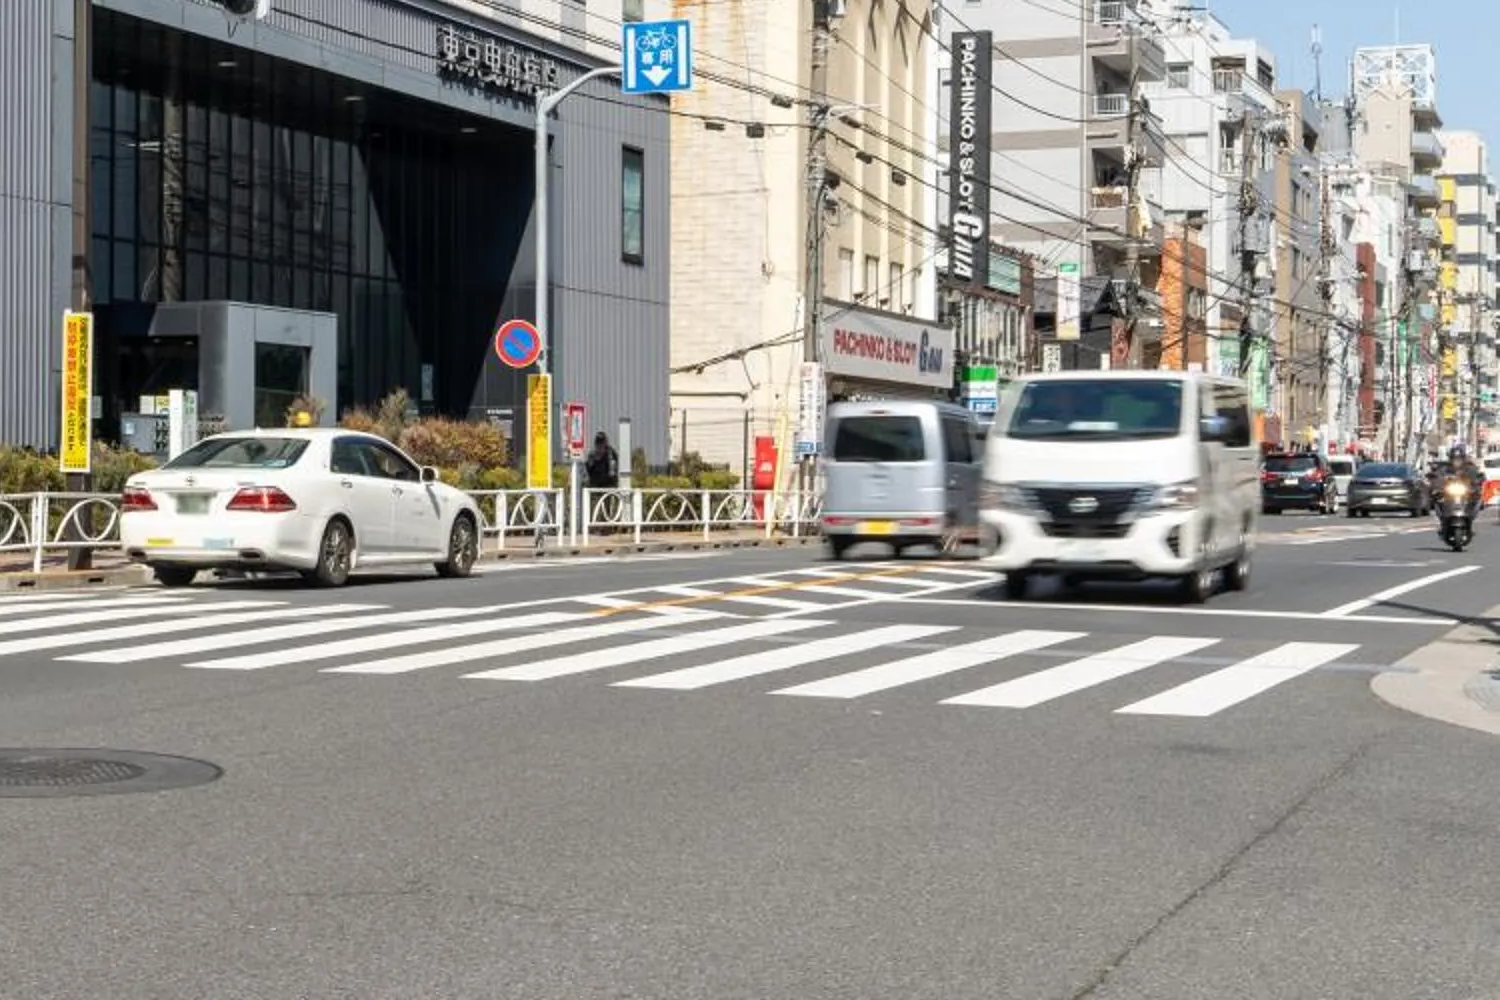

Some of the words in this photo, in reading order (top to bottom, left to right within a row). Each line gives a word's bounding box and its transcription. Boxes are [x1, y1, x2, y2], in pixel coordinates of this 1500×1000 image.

[960, 38, 976, 139] PACHINKO
[959, 141, 975, 157] &
[959, 157, 975, 210] SLOT
[833, 328, 885, 361] PACHINKO
[893, 338, 917, 366] SLOT
